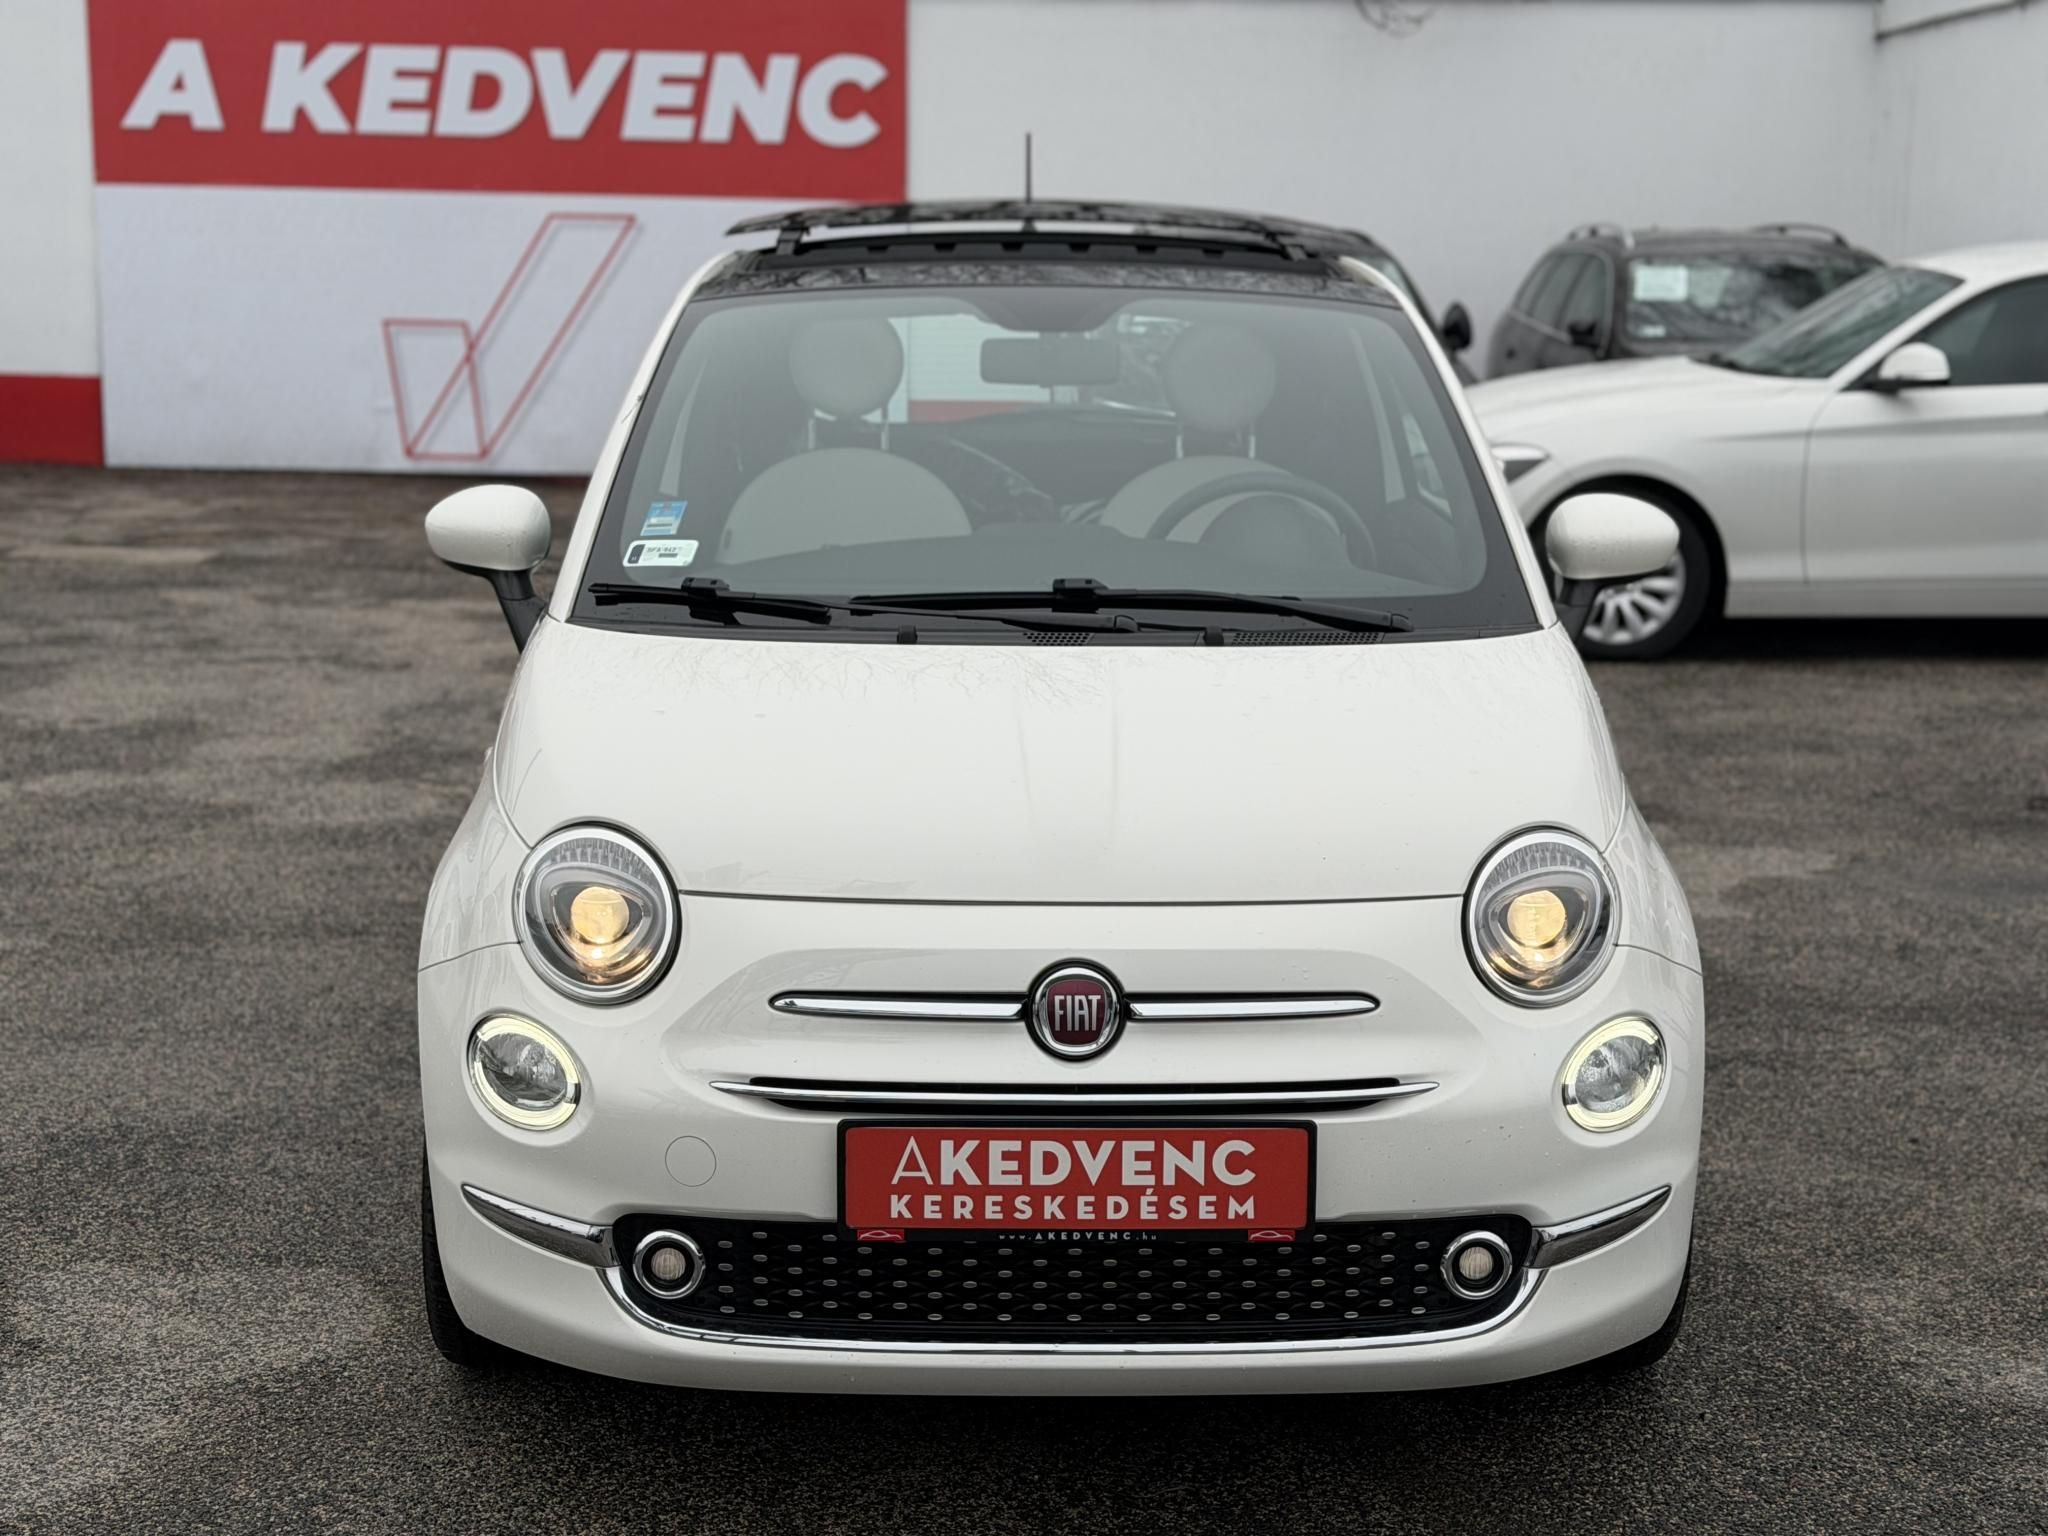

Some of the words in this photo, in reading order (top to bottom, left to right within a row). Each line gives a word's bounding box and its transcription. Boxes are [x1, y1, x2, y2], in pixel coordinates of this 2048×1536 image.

[120, 39, 224, 131] A
[261, 41, 889, 149] KEDVENC
[1054, 995, 1101, 1031] FIAT
[890, 1188, 1255, 1220] KERESKEDÉSEM
